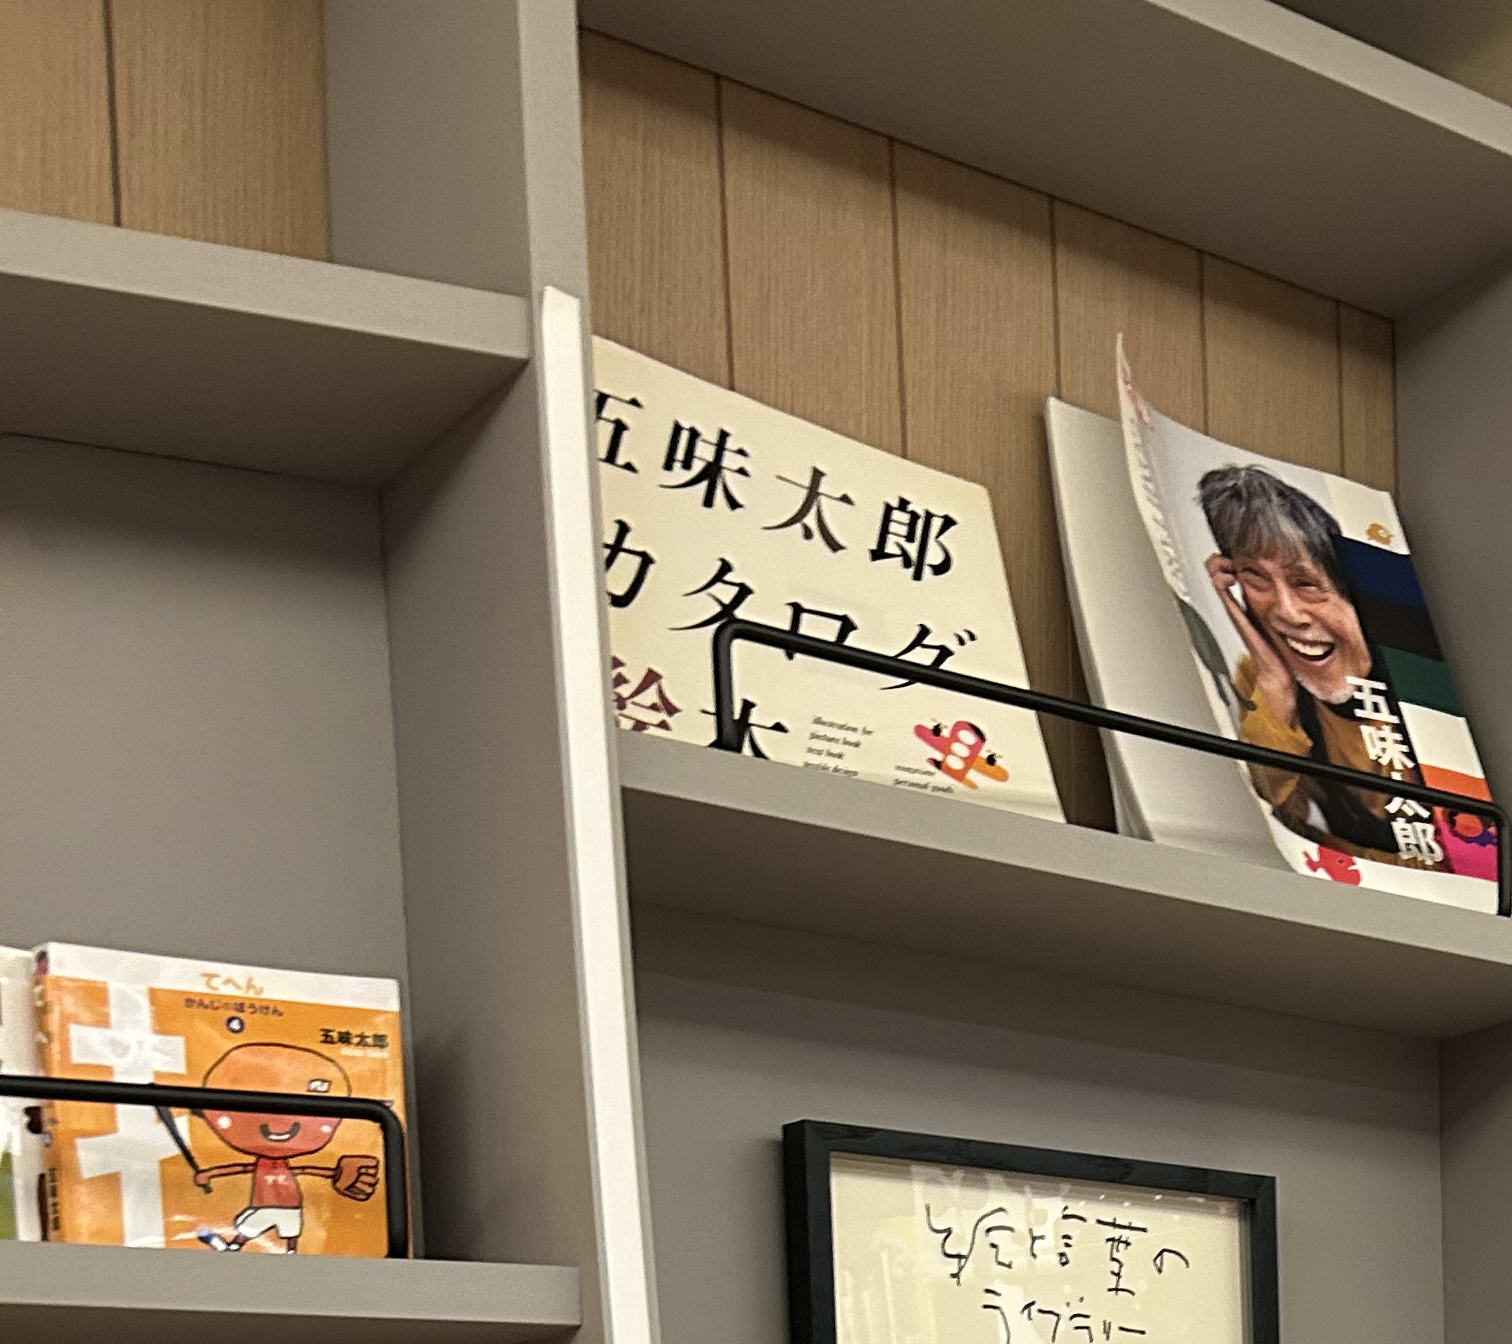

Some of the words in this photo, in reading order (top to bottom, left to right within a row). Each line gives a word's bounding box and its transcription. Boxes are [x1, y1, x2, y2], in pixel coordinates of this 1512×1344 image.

[594, 389, 959, 582] 五味太郎
[602, 519, 978, 690] カタログ
[200, 971, 264, 996] てへん
[319, 1028, 390, 1050] 五味太郎
